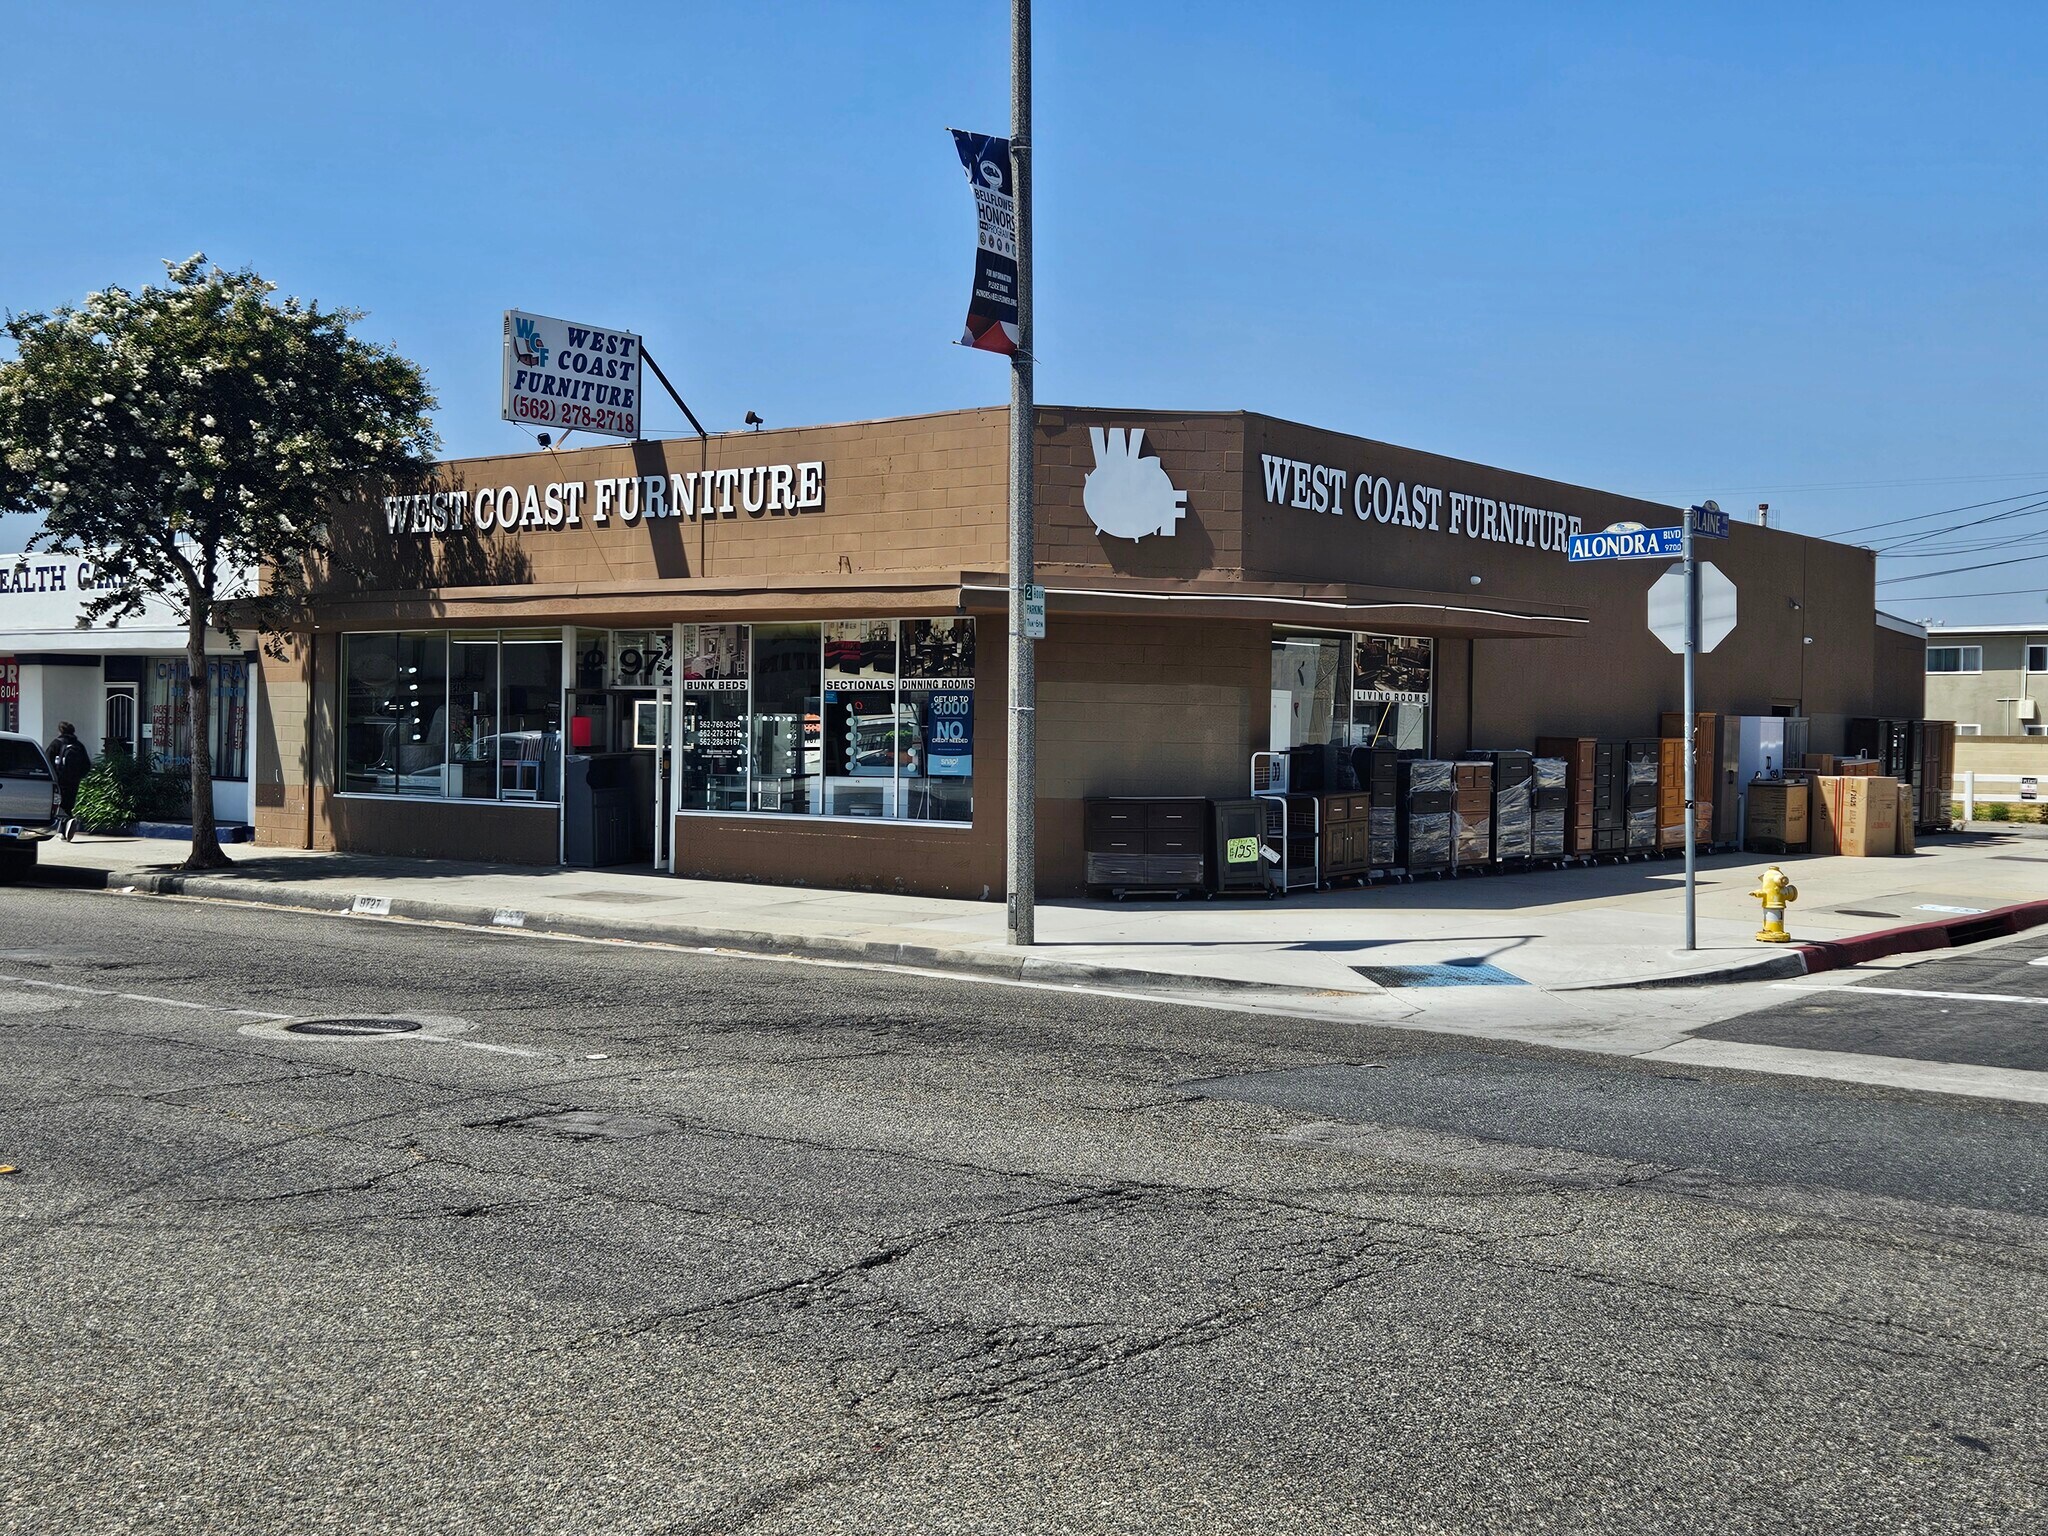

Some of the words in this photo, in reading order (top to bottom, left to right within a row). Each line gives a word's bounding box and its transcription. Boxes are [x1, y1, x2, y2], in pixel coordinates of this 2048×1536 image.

[975, 188, 1014, 212] BELLFLOWE
[978, 202, 1015, 232] HONORS
[568, 327, 635, 357] WEST
[558, 351, 635, 381] COAST
[514, 370, 634, 408] FURNITURE
[514, 394, 556, 421] (562)
[562, 403, 634, 433] 278-2718
[384, 491, 467, 534] WEST
[475, 481, 585, 531] COAST
[593, 462, 824, 521] FURNITURE
[1261, 453, 1346, 515] WEST
[1354, 473, 1442, 531] COAST
[1693, 510, 1720, 534] BLAINE
[1572, 533, 1659, 558] ALONDRA
[1663, 530, 1681, 540] BLVD
[1664, 543, 1682, 552] 9700
[1026, 586, 1032, 599] 2
[687, 681, 715, 690] BUNK
[719, 681, 746, 690] BEDS
[826, 680, 894, 690] SECTIONALS
[902, 680, 938, 689] DINNING
[942, 679, 974, 689] ROOMS
[933, 695, 947, 703] GET
[948, 695, 958, 703] UP
[959, 695, 969, 703] TO
[1357, 692, 1390, 701] LIVING
[1394, 693, 1426, 702] ROOMS
[931, 702, 969, 716] $3,000
[699, 720, 741, 728] 562-760-2054
[936, 721, 963, 739] NO
[699, 738, 741, 746] 562-280-9167
[360, 897, 381, 908] 9727
